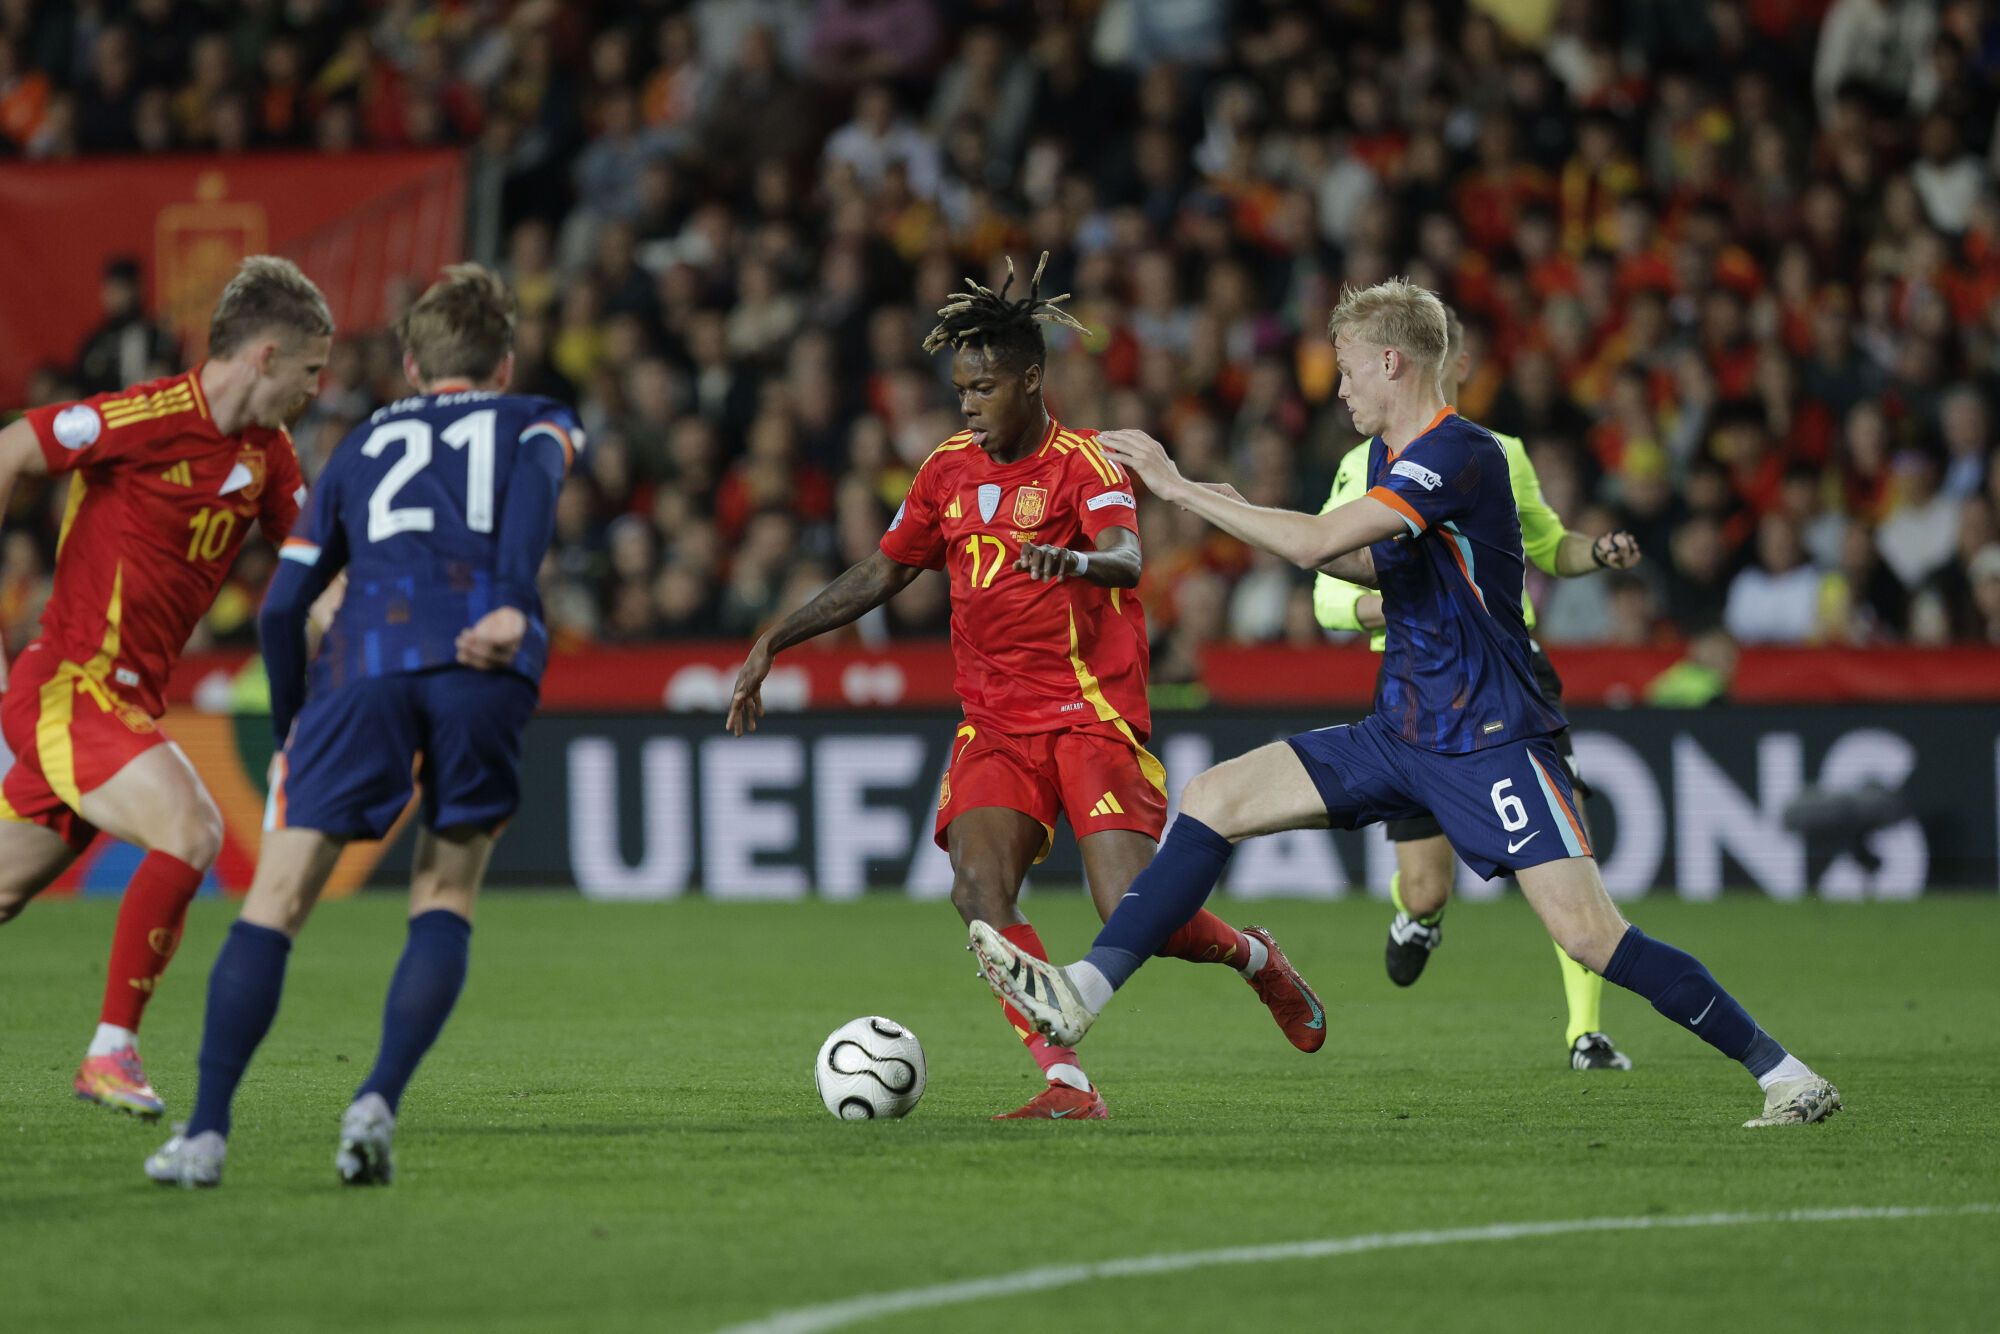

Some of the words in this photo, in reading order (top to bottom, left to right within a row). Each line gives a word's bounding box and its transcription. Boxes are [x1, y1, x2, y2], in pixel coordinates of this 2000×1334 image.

[360, 409, 497, 543] 21
[187, 506, 236, 562] 10
[966, 534, 1006, 588] 17
[1490, 777, 1529, 833] 6
